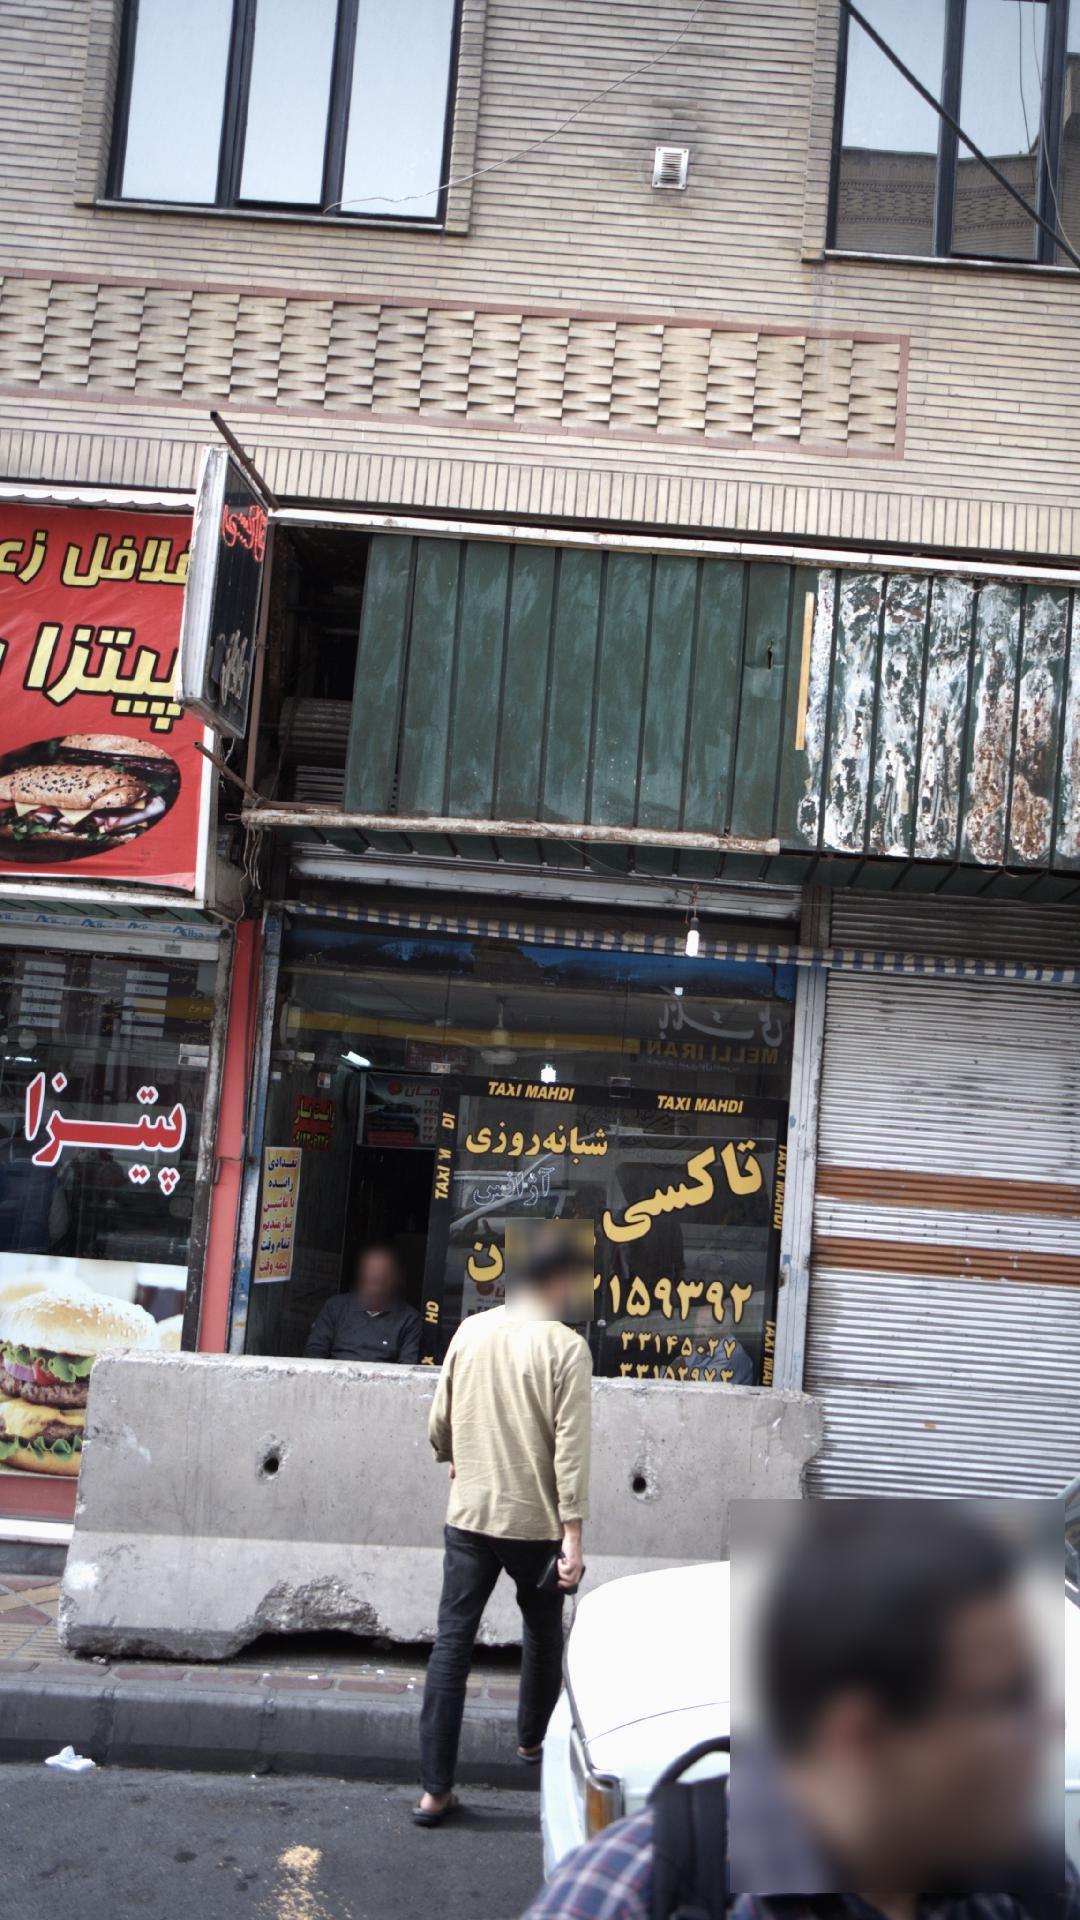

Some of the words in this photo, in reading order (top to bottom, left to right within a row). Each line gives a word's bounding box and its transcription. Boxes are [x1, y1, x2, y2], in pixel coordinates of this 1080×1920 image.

[23, 622, 184, 732] پیتزا
[489, 1081, 521, 1096] TAXI
[525, 1084, 575, 1101] MAHDI
[657, 1095, 692, 1110] TAXI
[694, 1097, 744, 1113] MAHDI
[24, 1071, 187, 1195] پیتزا
[435, 1165, 450, 1199] TAXI
[601, 1138, 764, 1243] تاکسی
